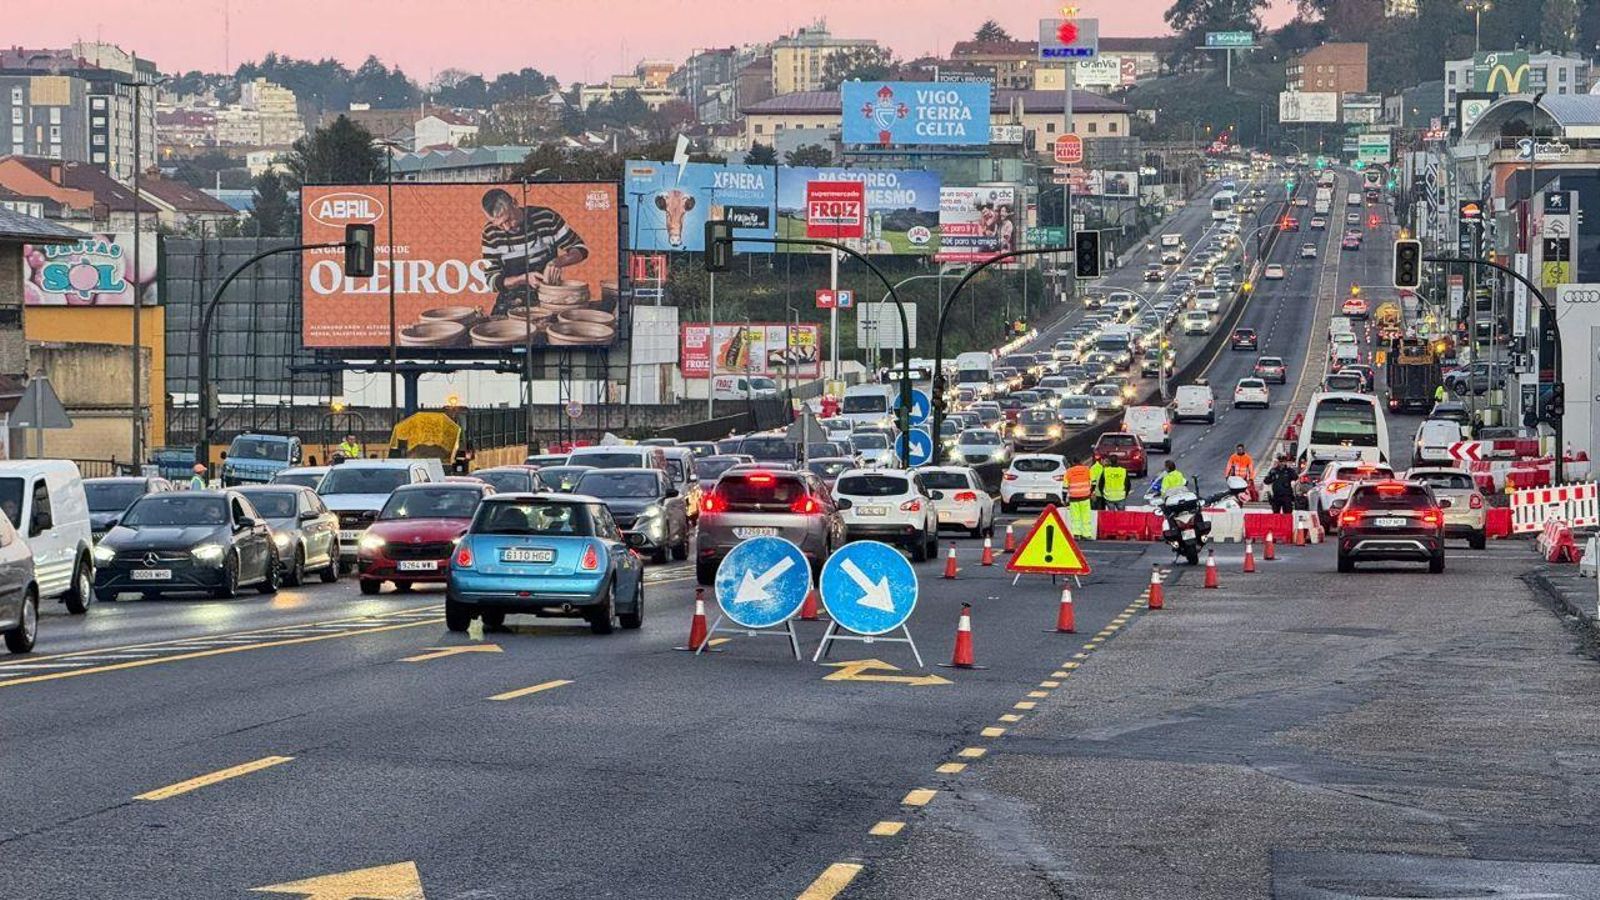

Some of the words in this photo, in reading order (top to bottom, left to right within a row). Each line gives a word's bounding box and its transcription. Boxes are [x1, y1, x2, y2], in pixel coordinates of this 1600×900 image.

[1042, 48, 1093, 57] SUZUKI
[916, 90, 963, 107] VIGO,
[916, 106, 972, 120] TERRA
[915, 122, 966, 136] CELTA
[1056, 149, 1080, 157] KING
[319, 200, 376, 218] ABRIL
[811, 203, 858, 217] FROIZ
